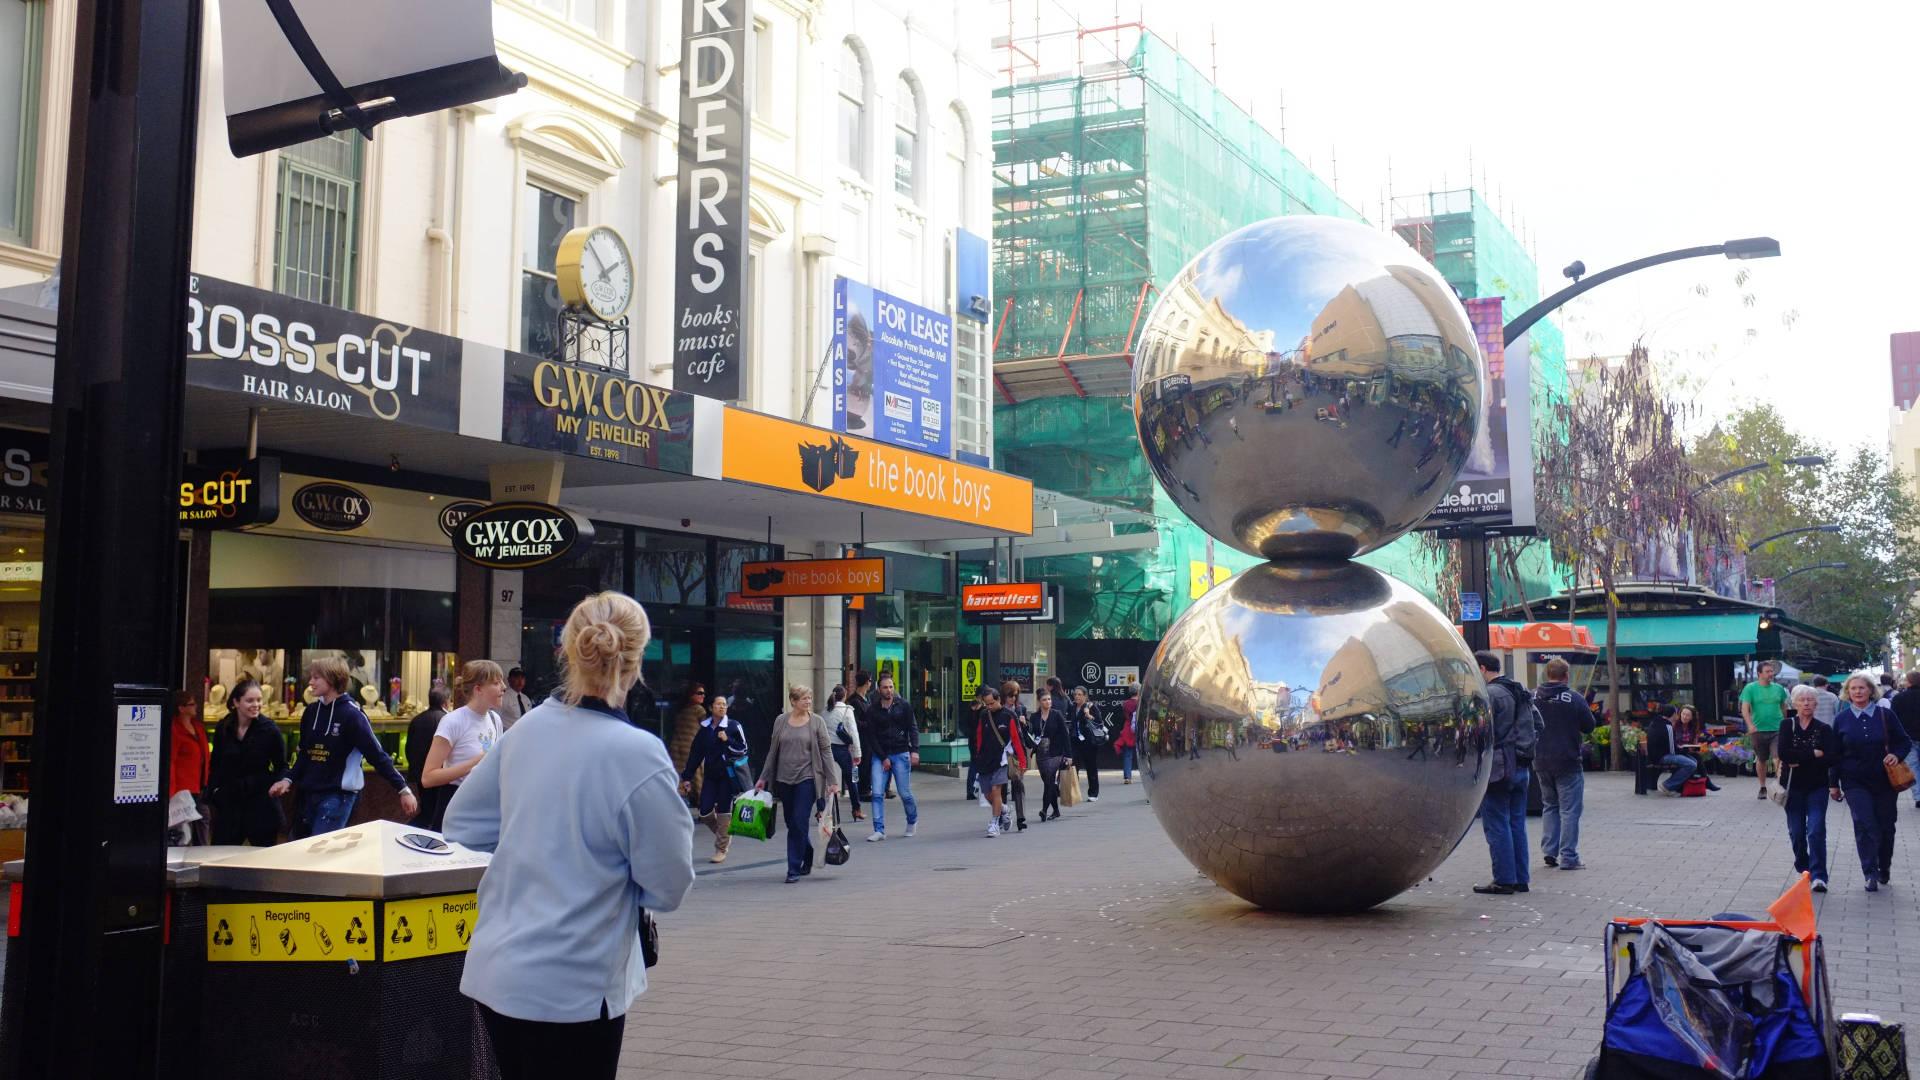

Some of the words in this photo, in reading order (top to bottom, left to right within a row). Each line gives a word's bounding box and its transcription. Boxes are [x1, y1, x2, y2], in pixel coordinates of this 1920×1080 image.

[681, 304, 733, 329] books
[878, 300, 906, 332] FOR
[911, 312, 949, 347] LEASE
[678, 327, 735, 352] music
[835, 292, 844, 411] LEASE
[336, 334, 431, 396] CUT
[687, 352, 725, 383] cafe
[242, 374, 289, 400] HAIR
[294, 385, 352, 411] SALON
[922, 400, 940, 414] CBRE
[557, 413, 581, 435] MY
[585, 420, 650, 449] JEWELLER
[203, 479, 252, 505] CUT
[868, 448, 899, 492] the
[904, 455, 946, 502] book
[953, 467, 991, 518] boys
[1471, 489, 1505, 505] mall
[190, 509, 217, 520] SALON
[475, 547, 495, 558] MY
[498, 544, 552, 559] JEWELLER
[787, 571, 807, 585] the
[811, 569, 842, 585] book
[848, 569, 880, 587] boys
[501, 590, 514, 602] 97
[966, 594, 1038, 607] haircutters
[265, 910, 310, 923] Recycling
